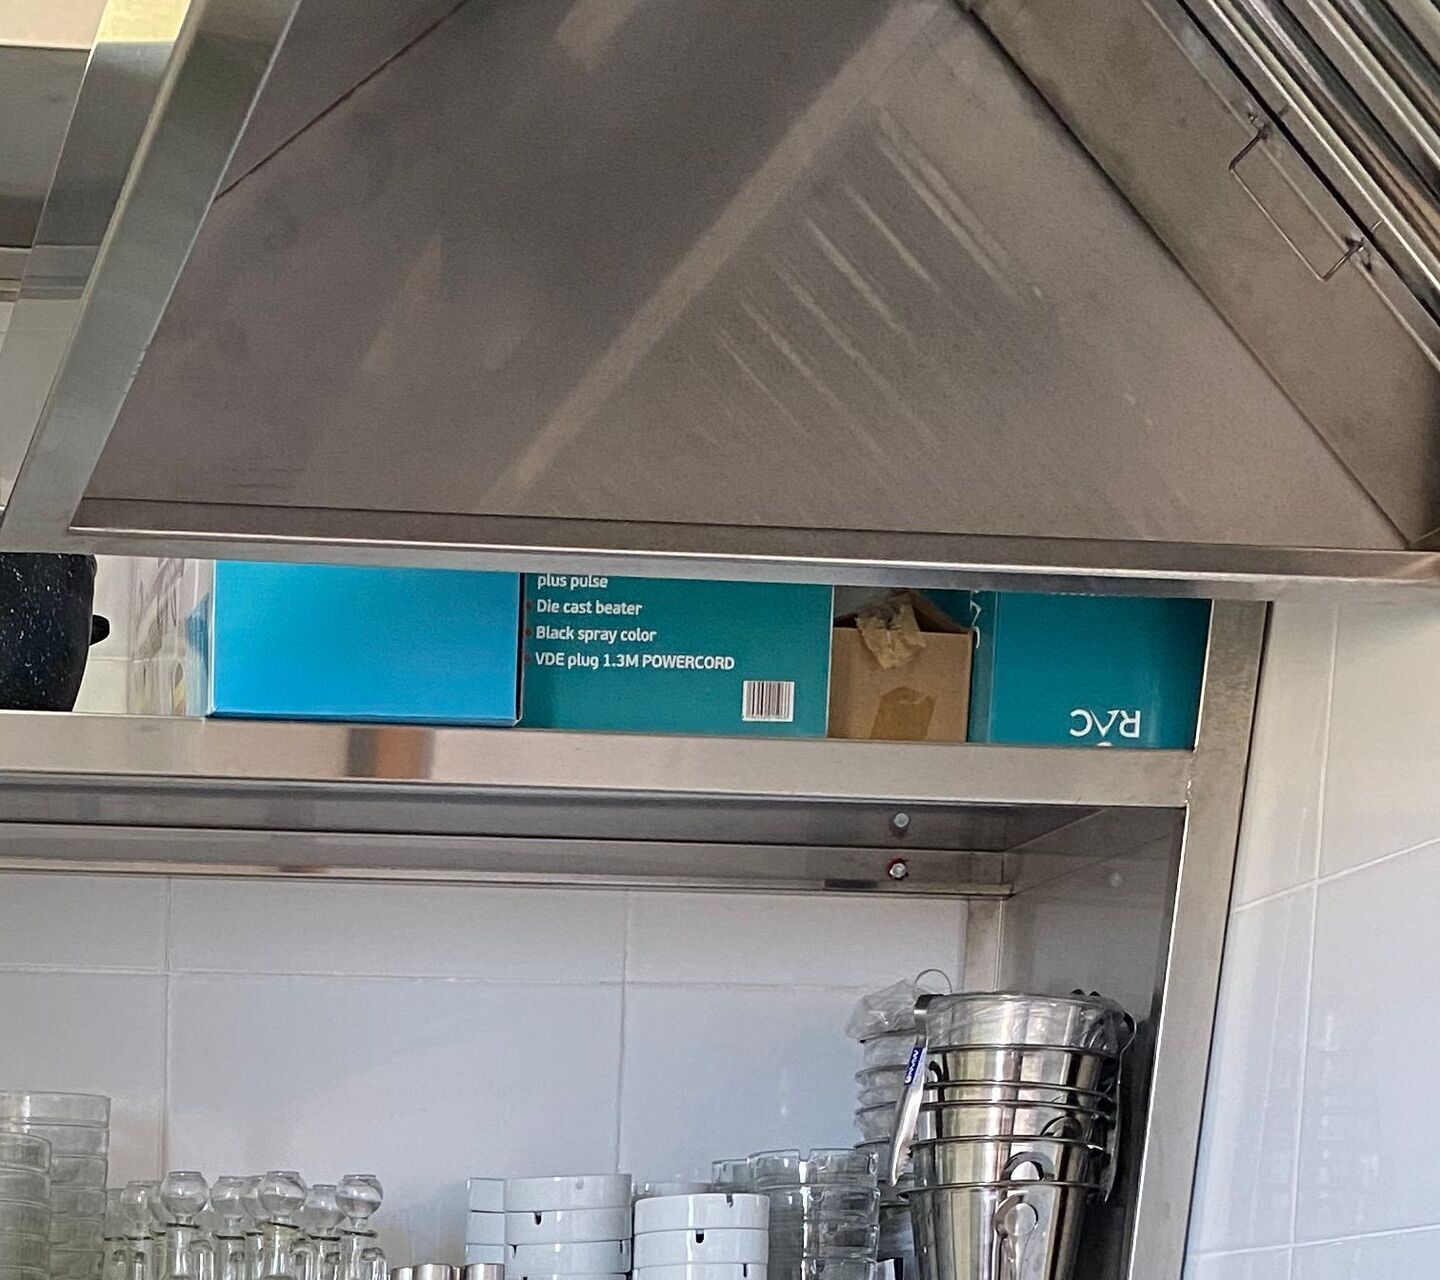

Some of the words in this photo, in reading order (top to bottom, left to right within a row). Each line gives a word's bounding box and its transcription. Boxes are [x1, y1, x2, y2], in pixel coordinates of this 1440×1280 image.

[537, 573, 567, 590] plus
[570, 575, 608, 590] pulse
[537, 599, 559, 613] Die
[563, 600, 593, 614] cast
[595, 600, 643, 615] beater
[536, 625, 574, 640] Black
[577, 628, 618, 644] spray
[620, 627, 657, 642] color
[535, 651, 565, 666] VDE
[567, 652, 599, 670] plug
[603, 653, 639, 668] 1.3M
[642, 654, 735, 670] POWERCORD
